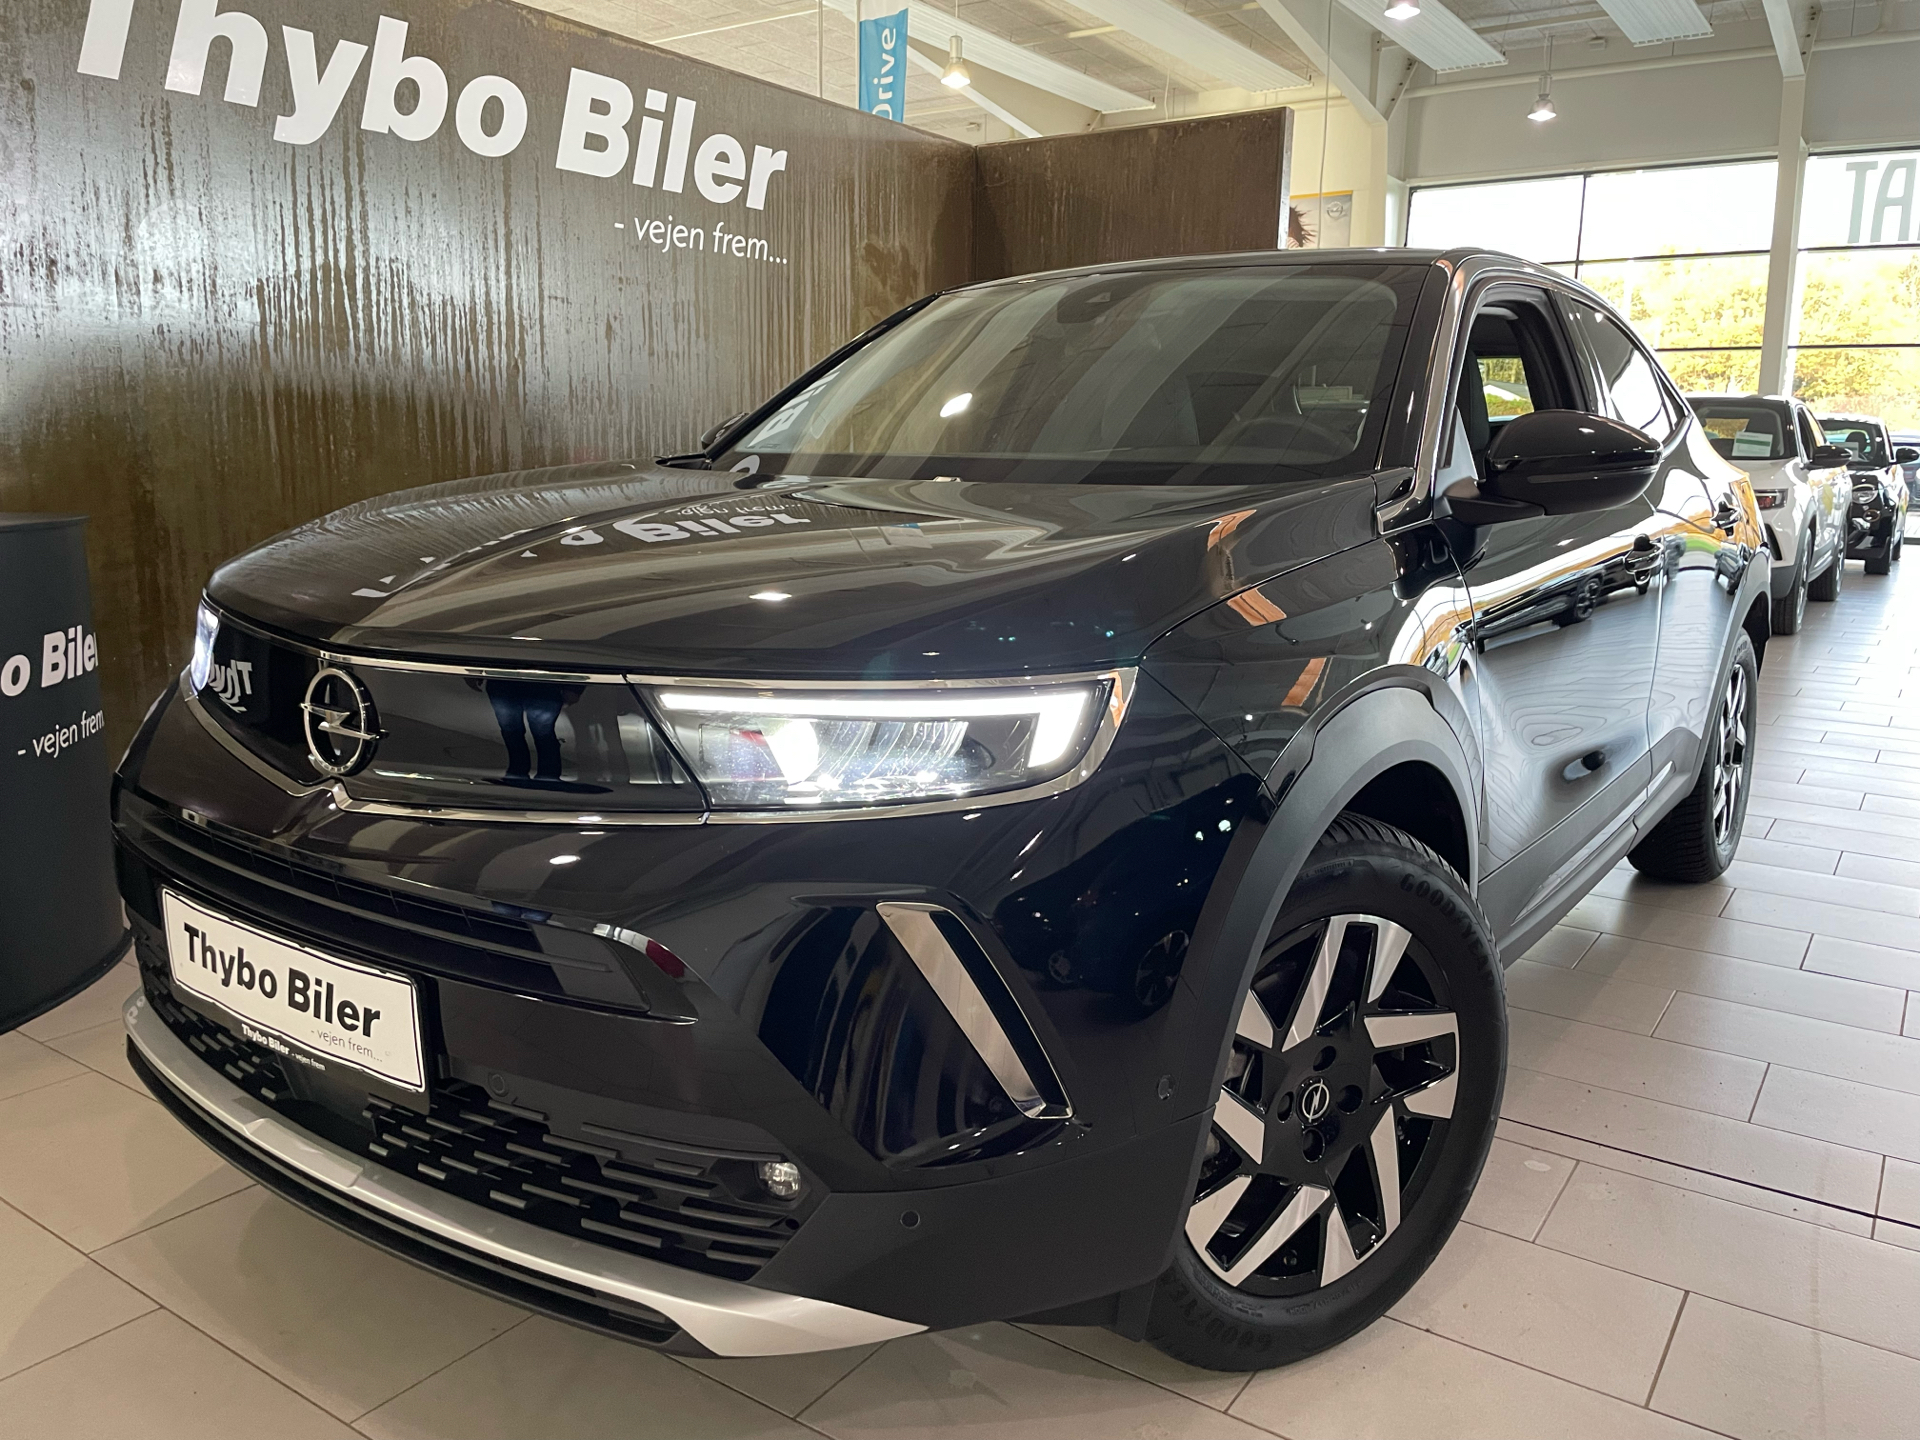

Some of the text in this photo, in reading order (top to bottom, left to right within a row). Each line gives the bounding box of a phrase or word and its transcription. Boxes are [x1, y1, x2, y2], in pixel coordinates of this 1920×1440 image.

[554, 67, 788, 211] Biler
[634, 214, 705, 253] vejen
[712, 221, 788, 265] frem...
[41, 625, 98, 688] Bile
[33, 724, 78, 758] vejen
[184, 922, 381, 1037] Thybo Biler
[241, 1023, 267, 1045] Thybo
[268, 1036, 290, 1055] Biler
[317, 1028, 346, 1048] vejen
[348, 1037, 383, 1062] frem...
